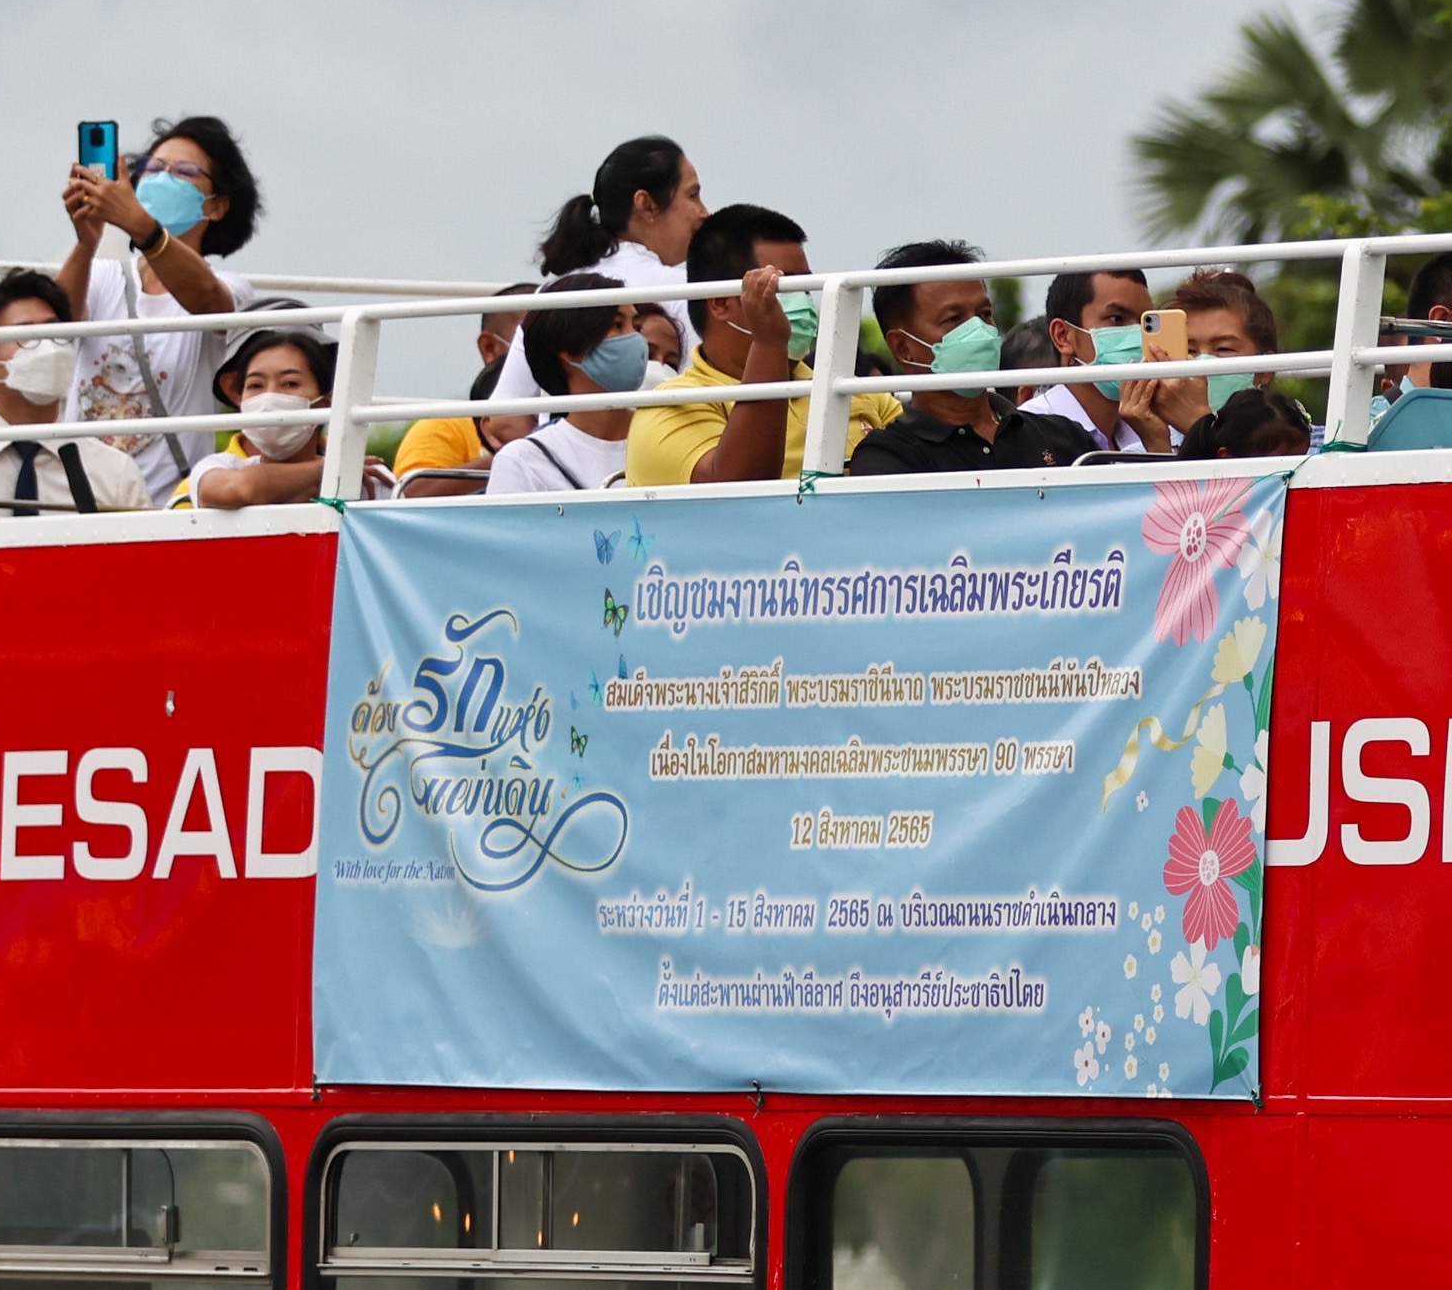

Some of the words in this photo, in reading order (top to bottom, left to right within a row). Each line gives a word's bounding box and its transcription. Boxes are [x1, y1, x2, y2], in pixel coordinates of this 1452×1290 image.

[636, 548, 1125, 635] เชิญชมงานนิทรรศการเฉลิมพระเกียรติ
[605, 661, 782, 708] สมเด็จพระนางเจ้าสิริกิติ์
[786, 664, 923, 703] พระบรมราชินีนาถ
[930, 660, 1140, 700] พระบรมราชชนนีพันปีหลวง
[651, 734, 988, 776] เนื่องในโอกาสมหามงคลเฉลิมพระชนมพรรษา
[995, 742, 1017, 771] 90
[1024, 743, 1073, 770] พรรษา
[791, 816, 813, 845] 12
[818, 810, 882, 845] สิงหาคม
[887, 814, 932, 844] 2565
[334, 860, 362, 879] With
[363, 859, 385, 879] love
[381, 859, 403, 884] for
[403, 860, 424, 880] the
[599, 881, 690, 928] ระหว่างวันที่
[695, 900, 705, 928] 1
[726, 899, 748, 928] 15
[753, 893, 815, 928] สิงหาคม
[827, 897, 870, 927] 2565
[876, 902, 894, 927] ณ
[900, 889, 1117, 927] บริเวณถนนราชดำเนินกลาง
[657, 960, 844, 1008] ตั้งแต่สะพานผ่านฟ้าลีลาศ
[849, 967, 1045, 1019] ถึงอนุสาวรีย์ประชาธิปไตย
